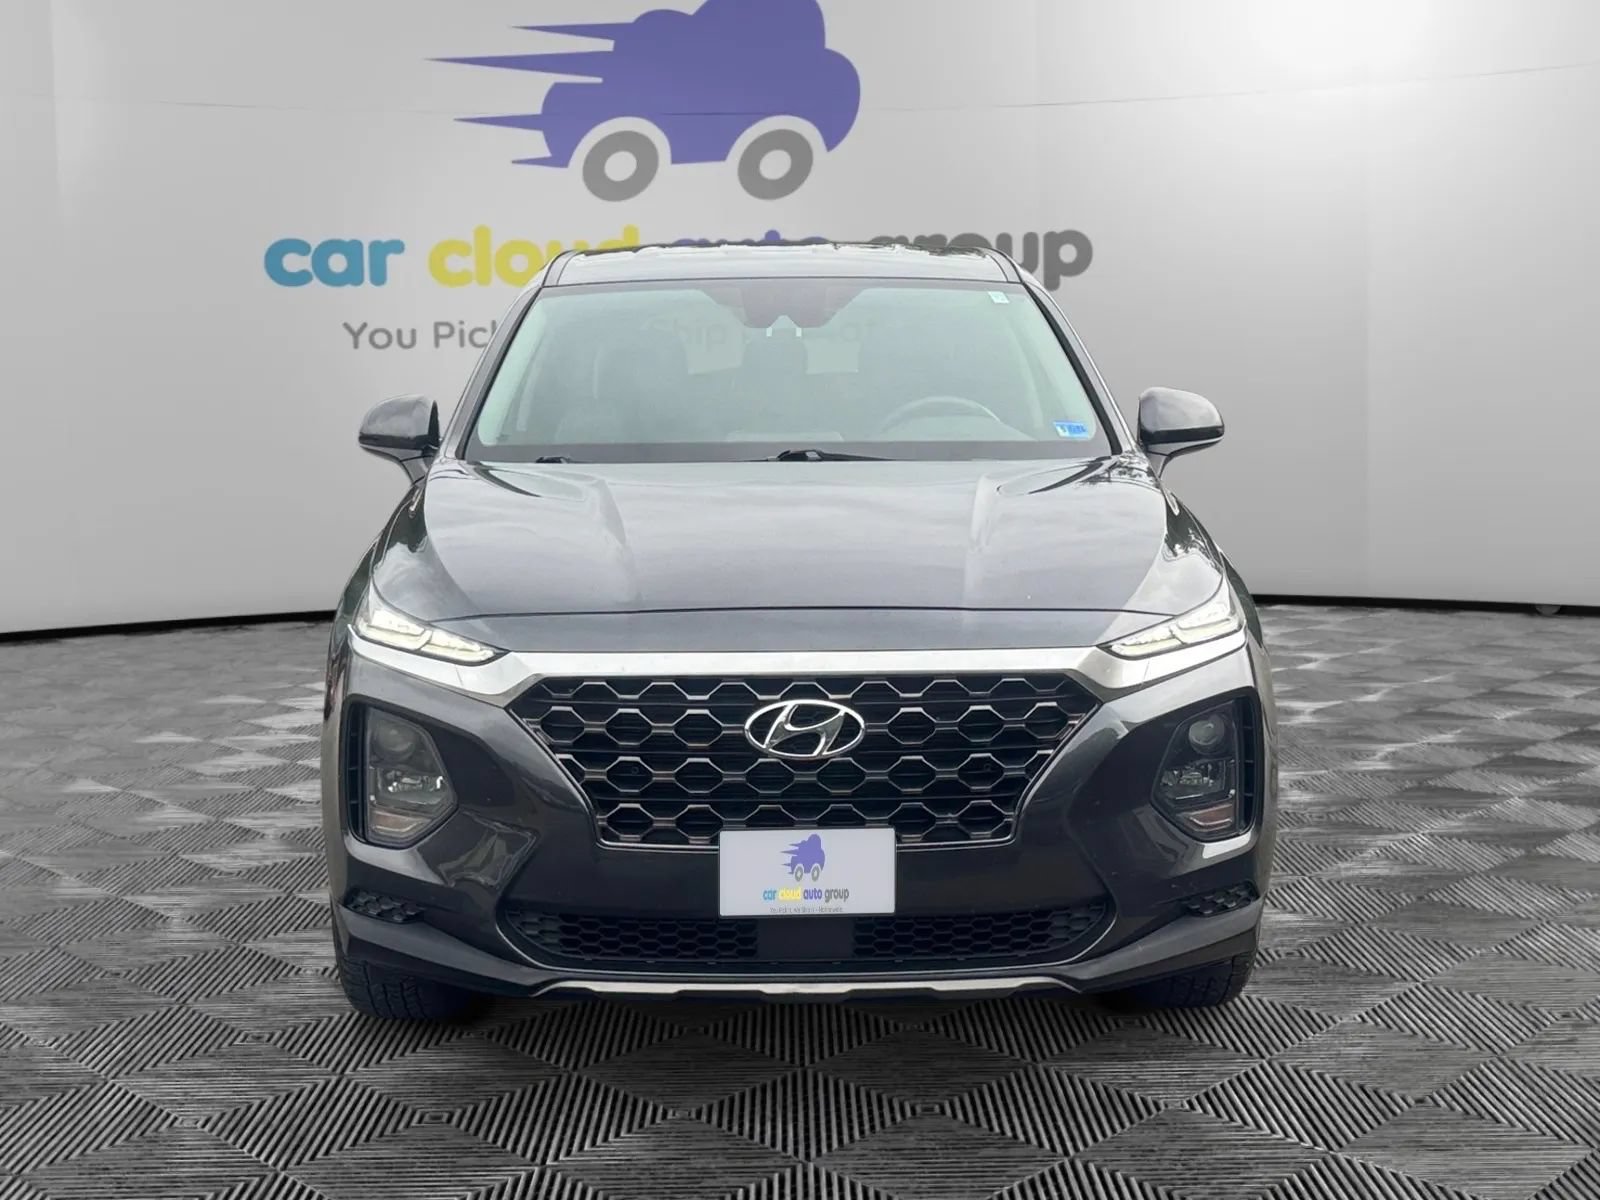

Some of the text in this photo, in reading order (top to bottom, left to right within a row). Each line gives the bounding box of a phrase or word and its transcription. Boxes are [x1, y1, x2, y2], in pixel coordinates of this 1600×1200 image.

[264, 238, 405, 287] car
[343, 322, 417, 350] You
[763, 890, 776, 900] car
[803, 888, 823, 900] auto
[824, 888, 849, 903] group
